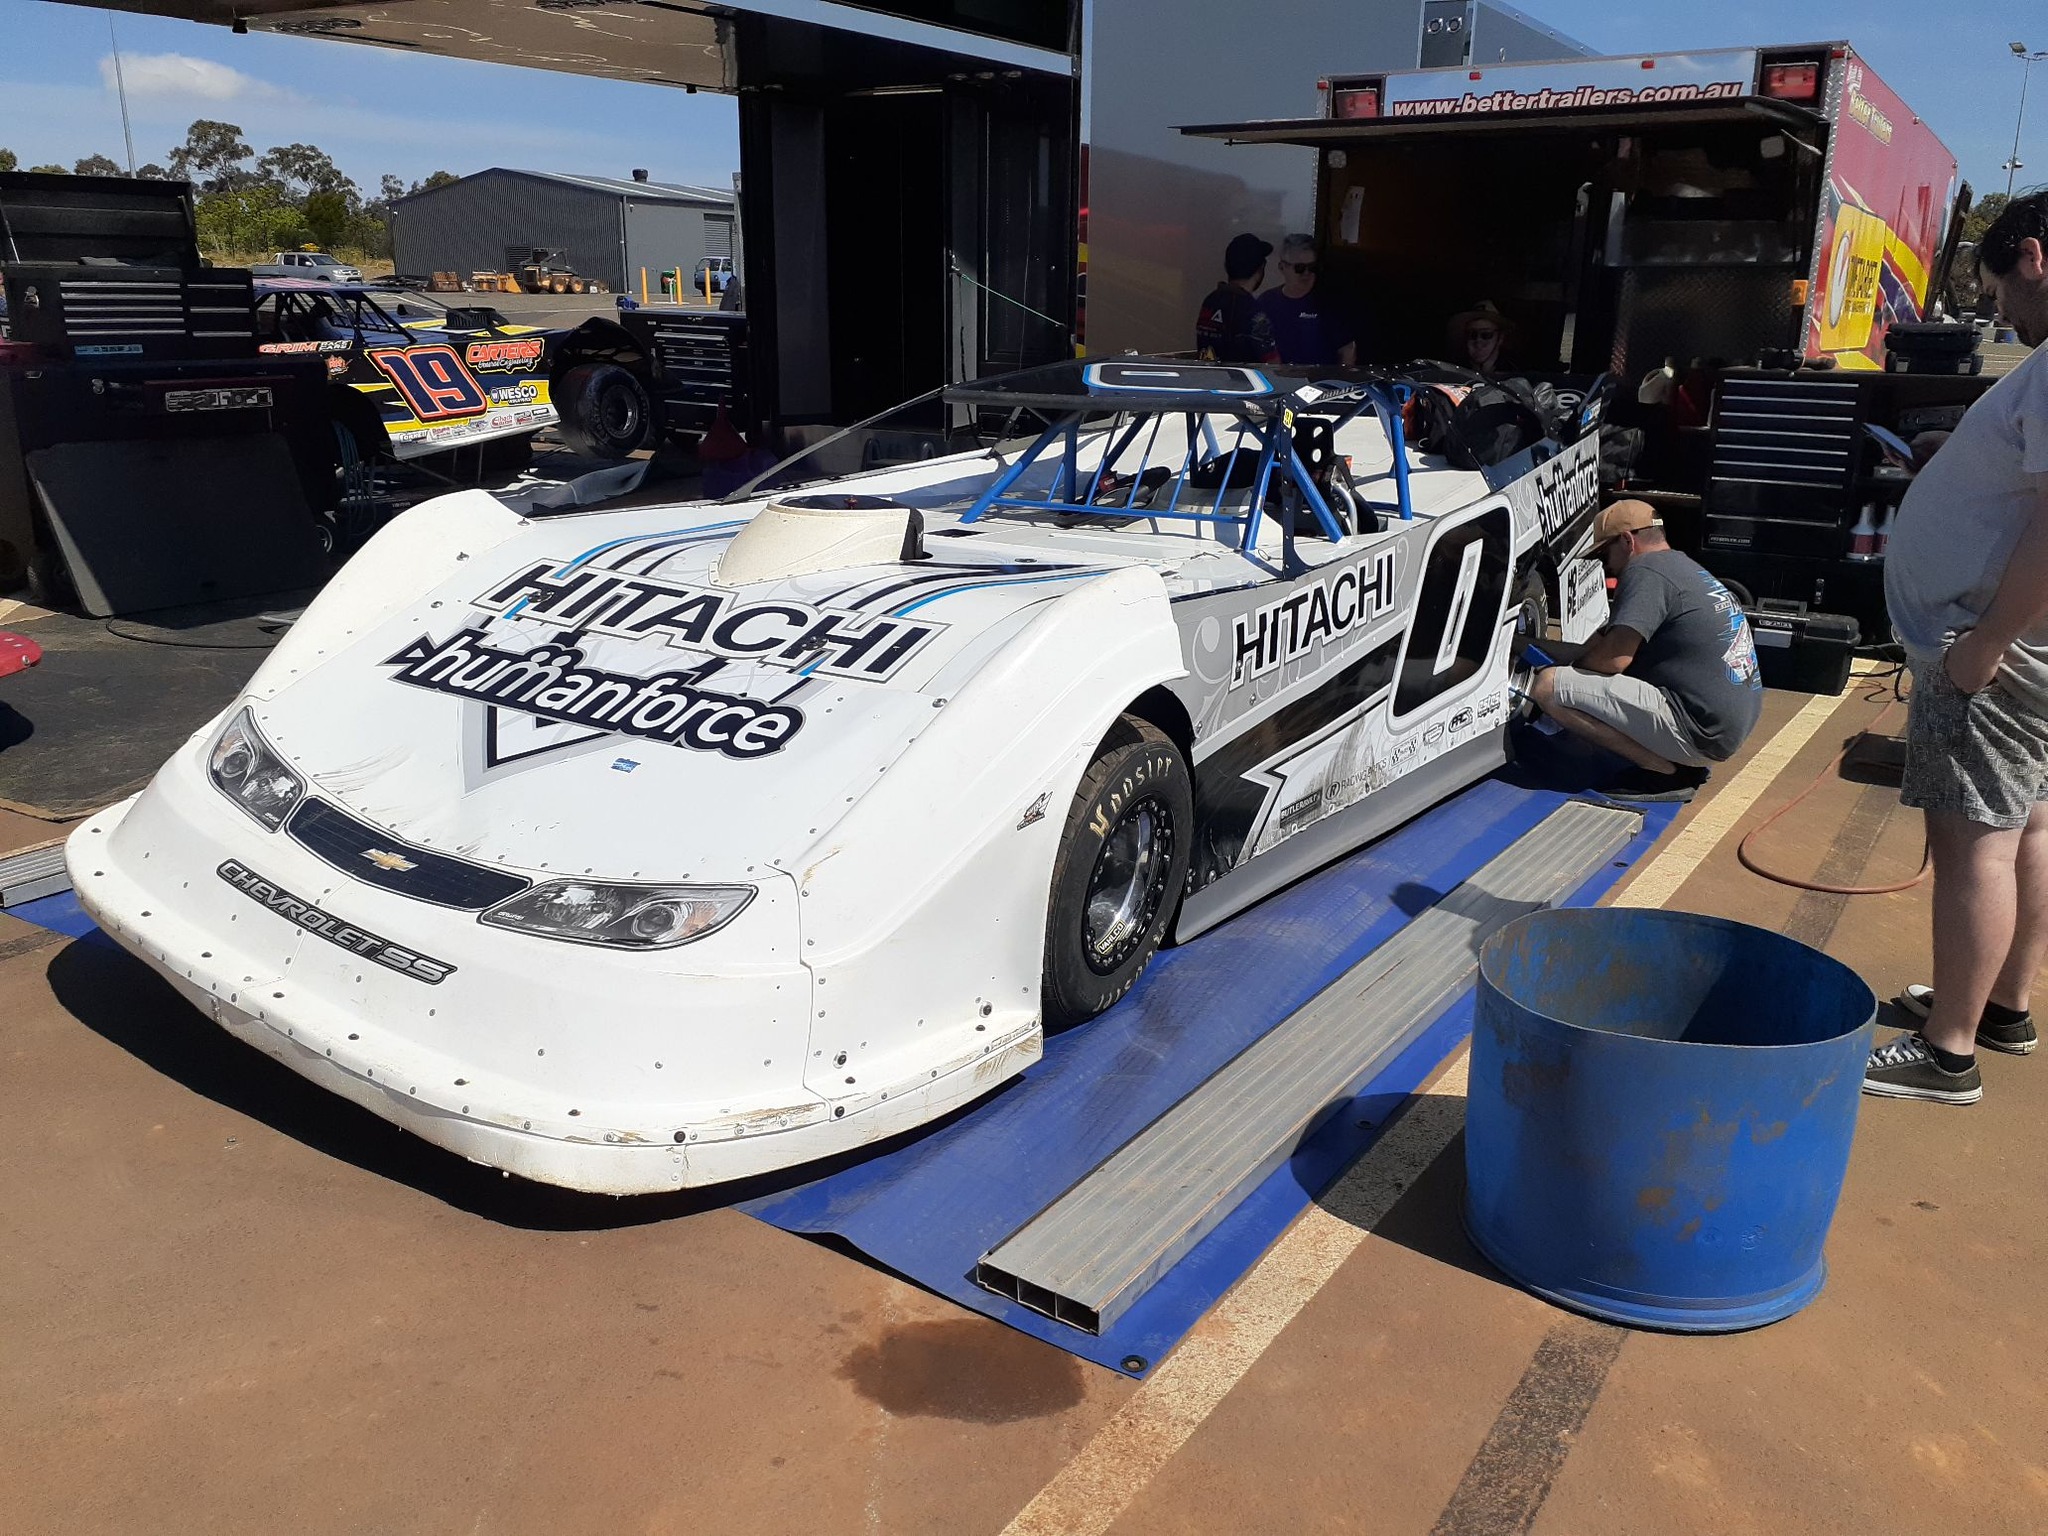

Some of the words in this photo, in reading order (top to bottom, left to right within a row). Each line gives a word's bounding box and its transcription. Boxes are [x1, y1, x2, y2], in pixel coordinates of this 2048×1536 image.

[1393, 81, 1743, 117] www.bettertrailers.com.au
[371, 347, 487, 419] 19
[498, 385, 537, 401] WESCO
[487, 564, 933, 676] HITACHI
[1232, 552, 1393, 683] HITACHI
[409, 634, 792, 749] humanforce
[220, 861, 382, 952] CHEVROLET
[378, 946, 452, 982] SS
[1099, 922, 1125, 951] VAHLCO
